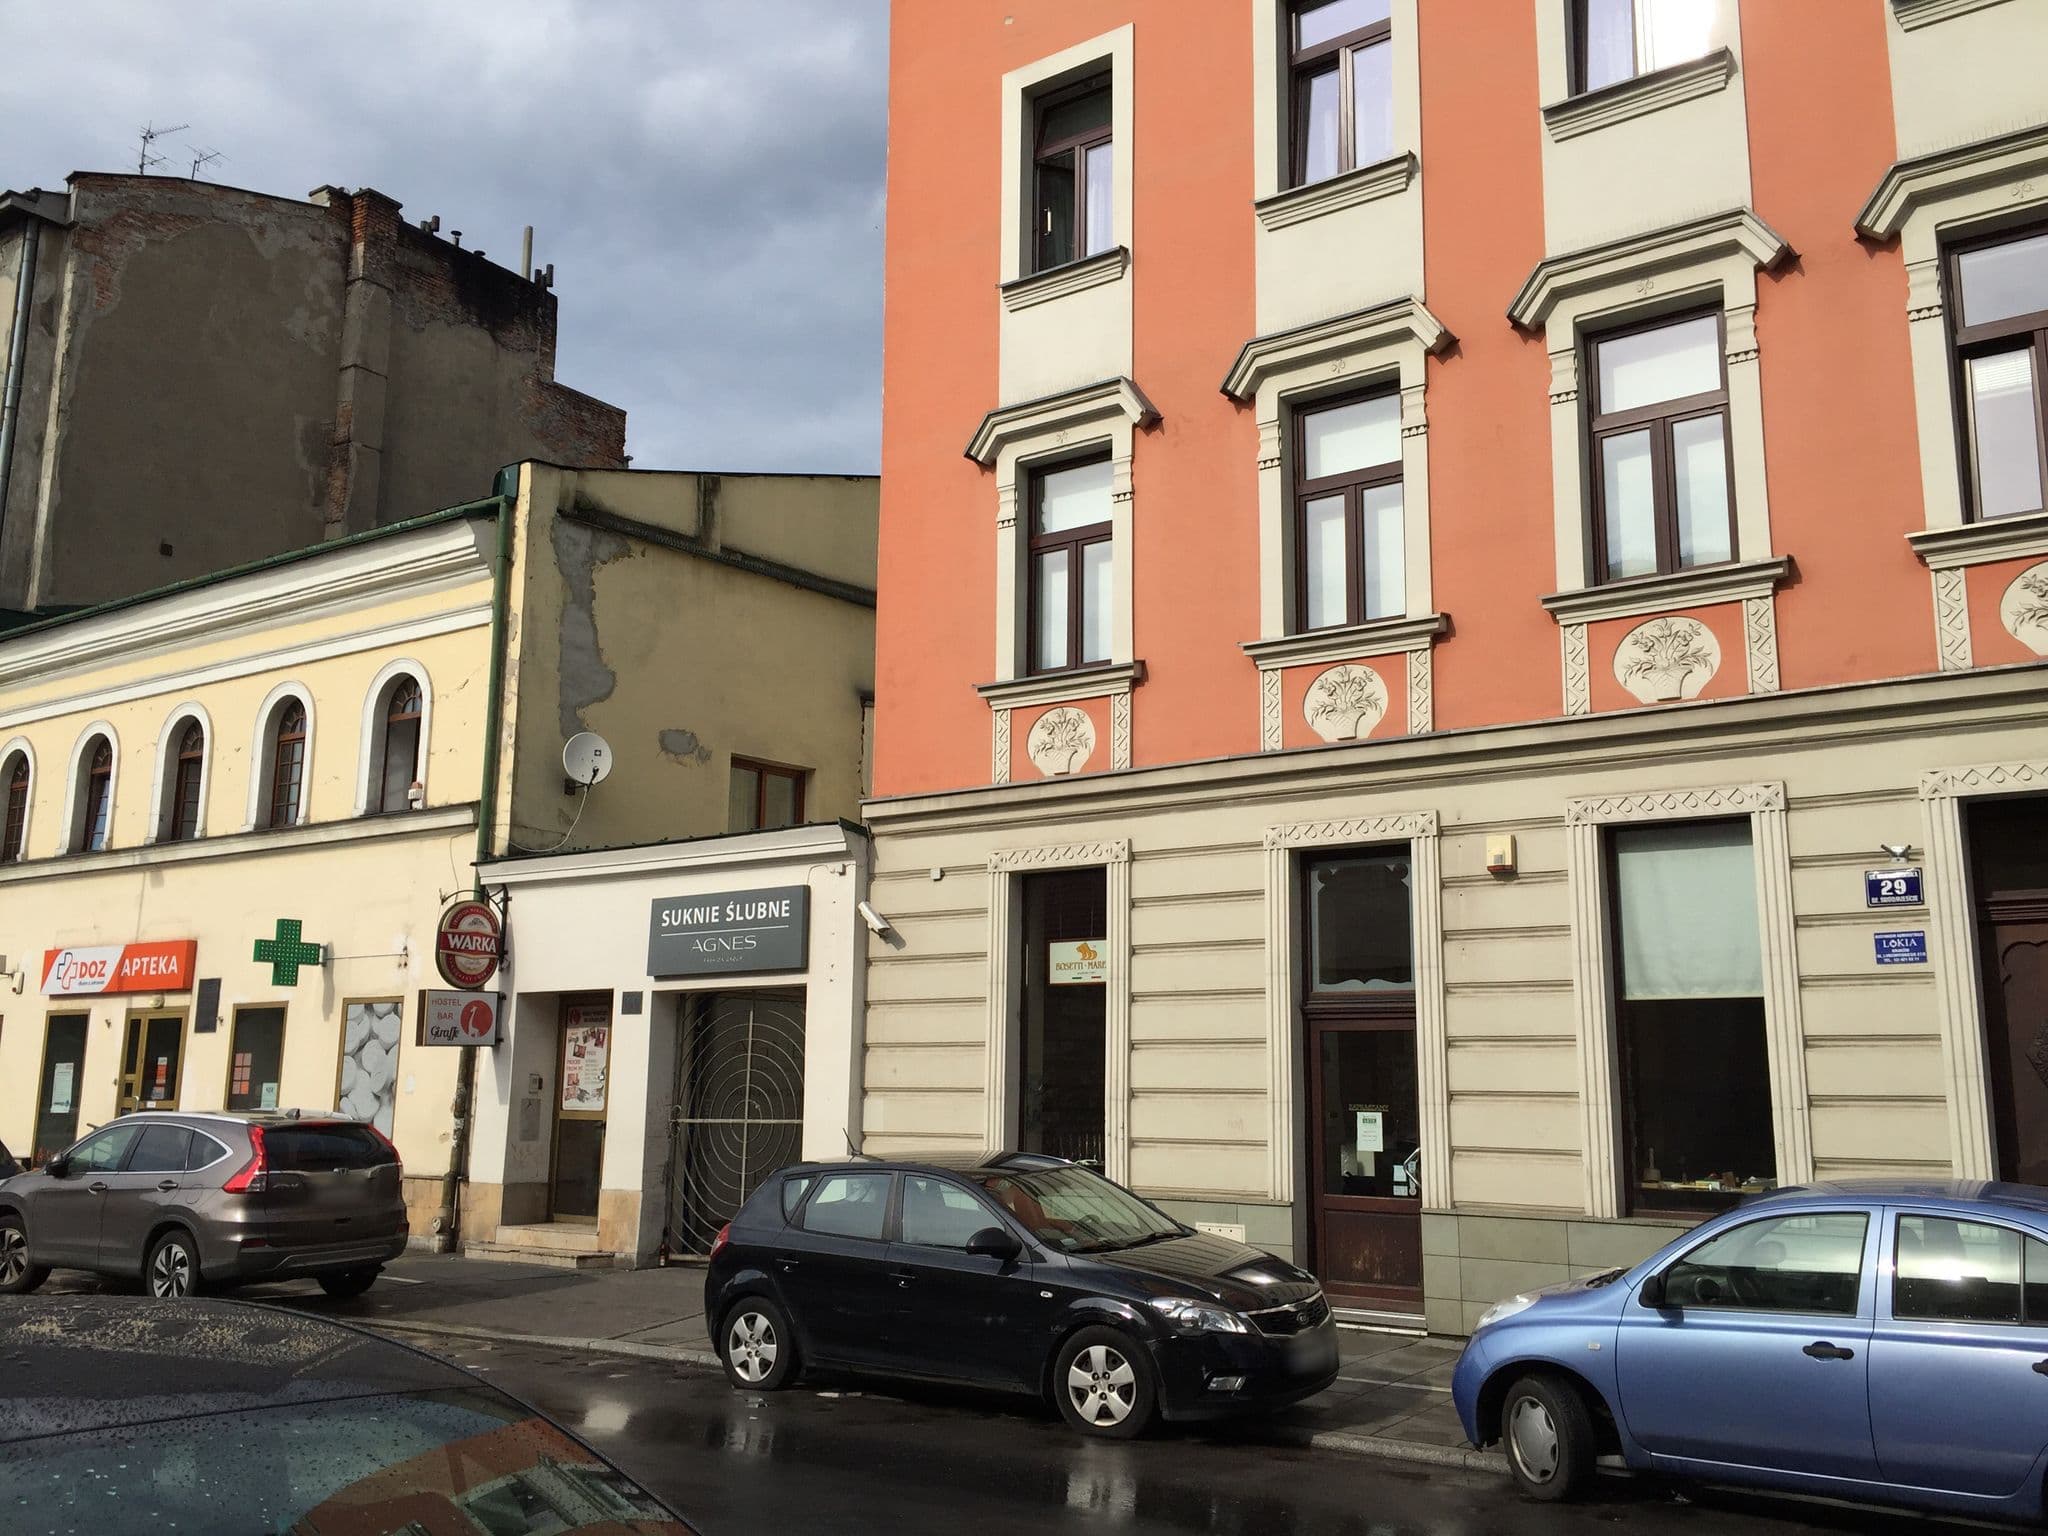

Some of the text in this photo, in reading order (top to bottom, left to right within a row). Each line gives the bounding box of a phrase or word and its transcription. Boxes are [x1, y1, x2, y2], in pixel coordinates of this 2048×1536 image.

[1880, 879, 1907, 896] 29
[661, 900, 790, 927] SUKNIE ŚLUBNE
[447, 933, 497, 953] WARKA
[692, 935, 757, 952] AGNES
[1883, 938, 1918, 948] LOKIA
[79, 955, 178, 978] DOZ APTEKA
[432, 998, 461, 1006] HOSTEL
[437, 1011, 454, 1020] BAR
